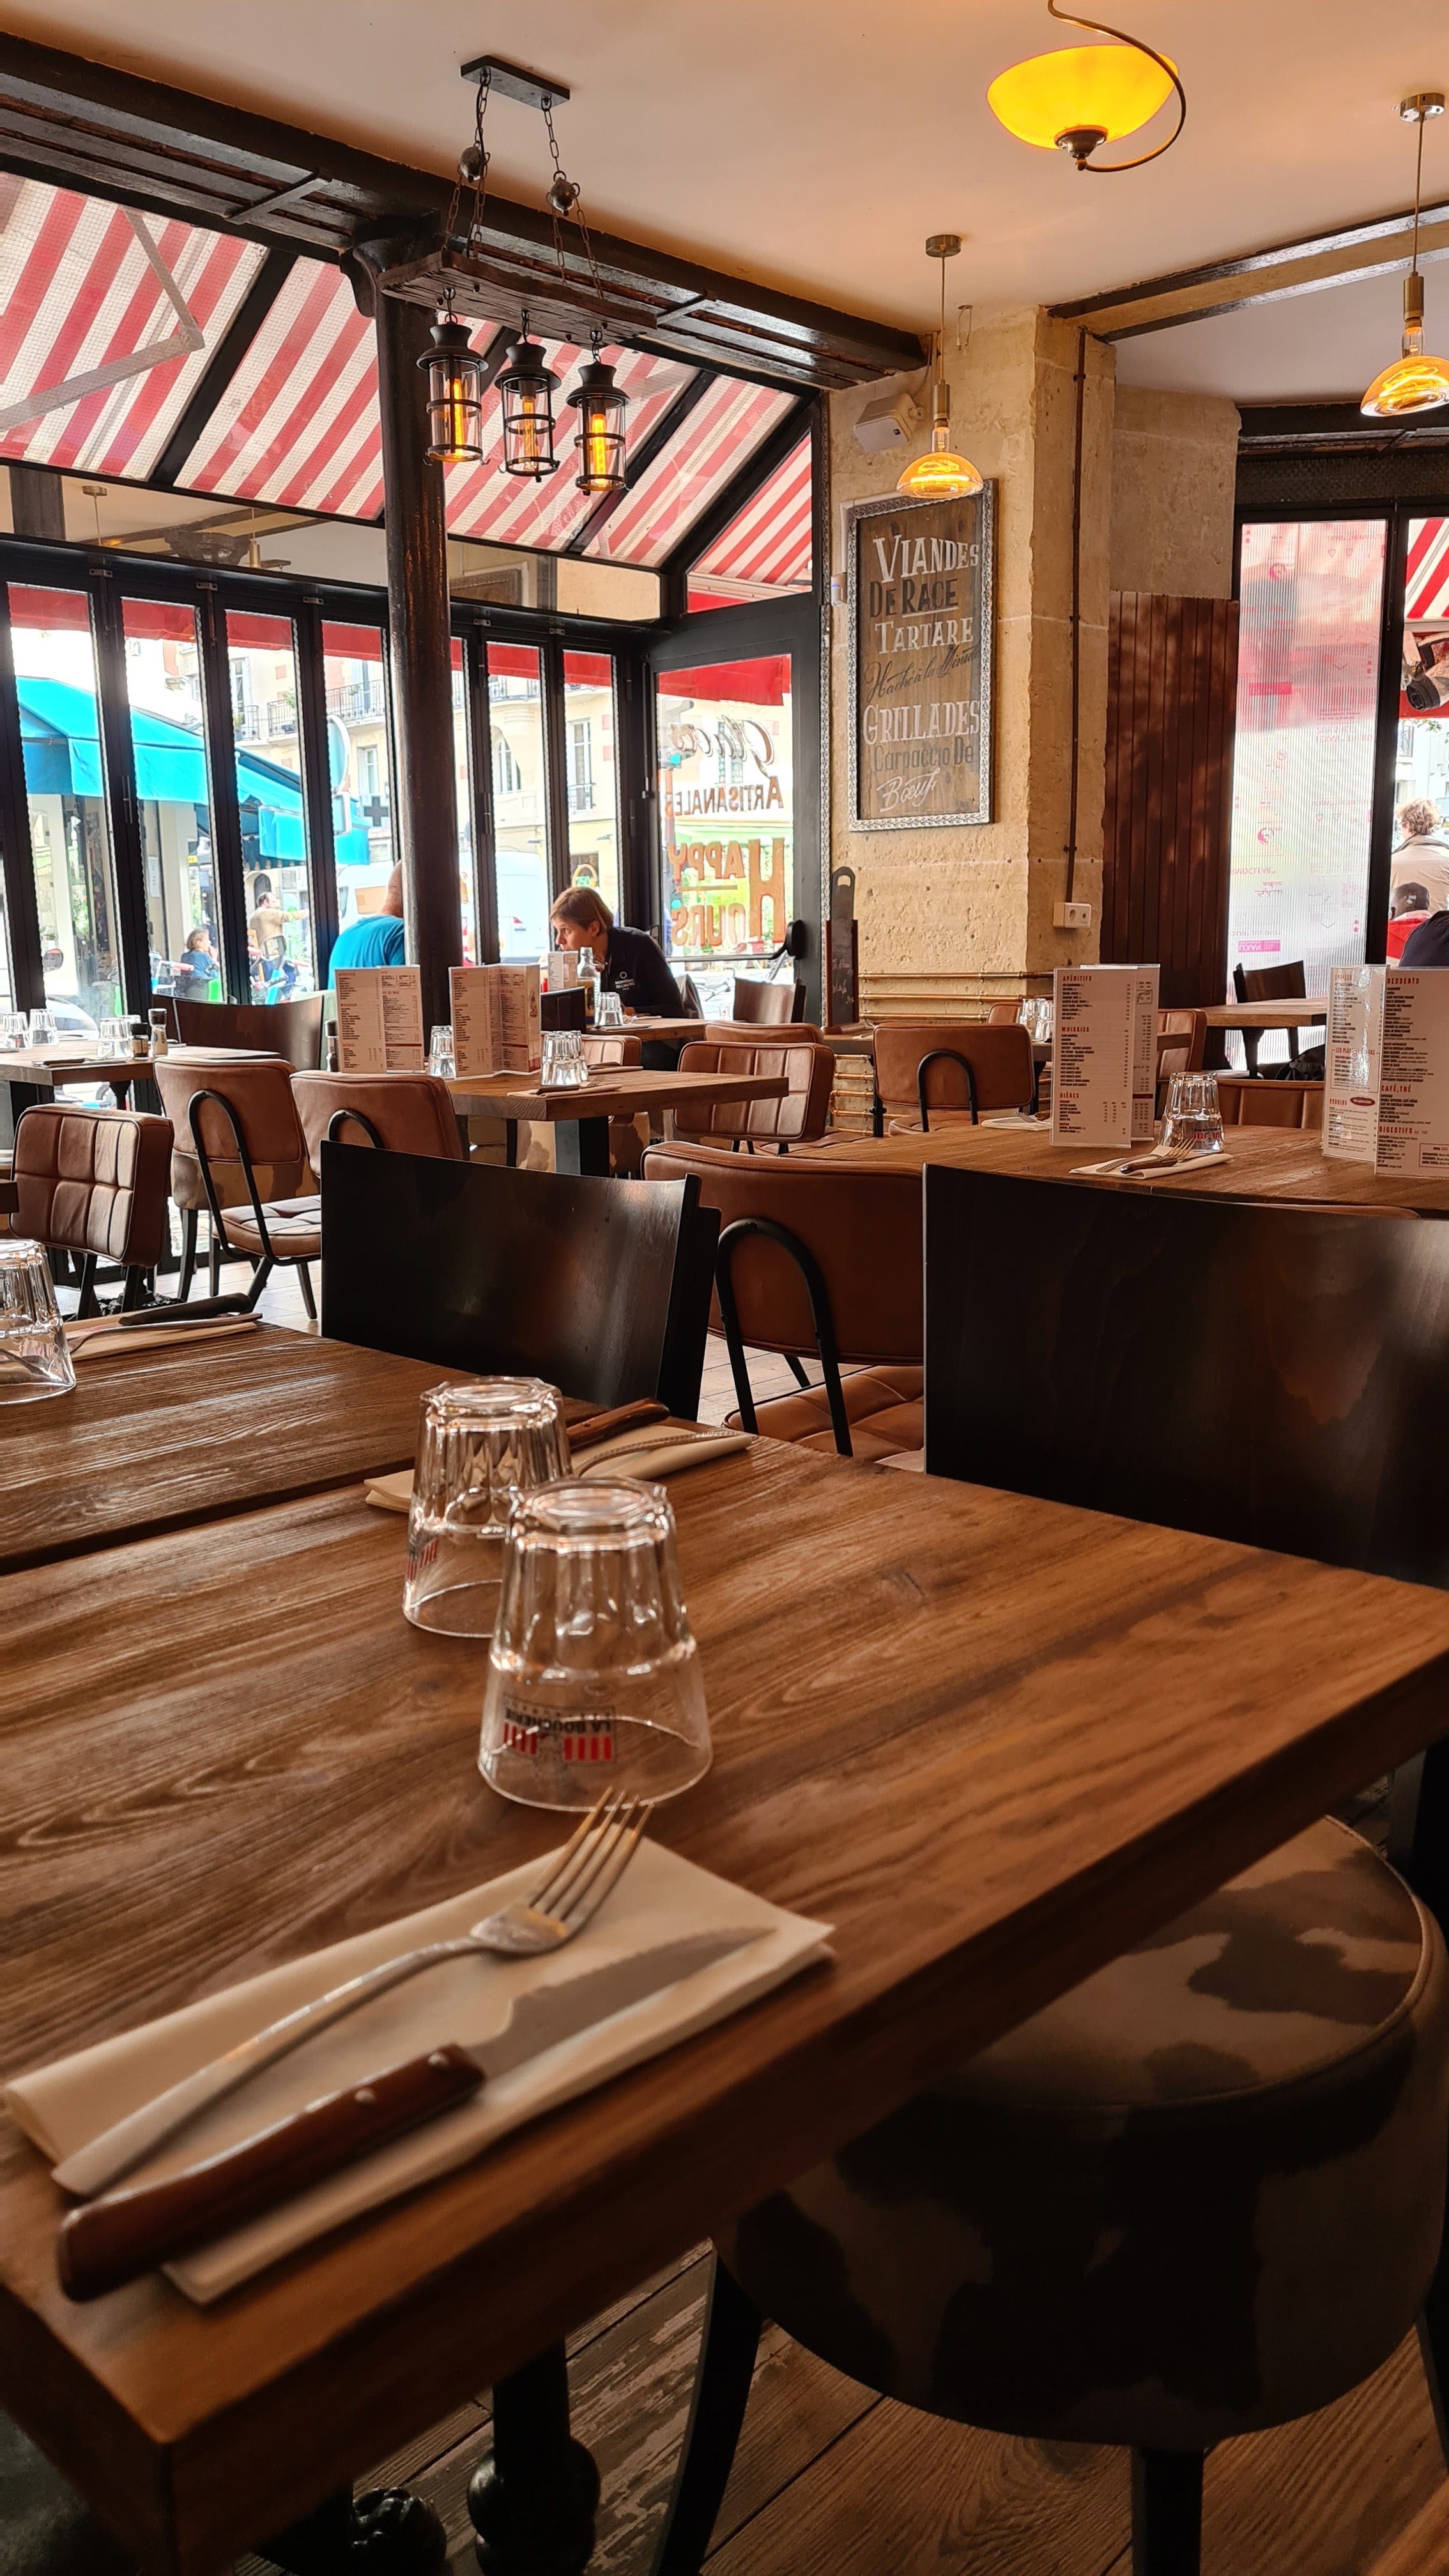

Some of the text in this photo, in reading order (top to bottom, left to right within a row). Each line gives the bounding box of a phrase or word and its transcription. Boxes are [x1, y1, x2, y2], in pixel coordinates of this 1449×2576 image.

[873, 535, 979, 583] VIANDES
[870, 578, 958, 618] DE RACE
[875, 617, 973, 654] TARTARE
[863, 700, 980, 746] GRILLADES
[874, 736, 974, 775] Carpaccio De
